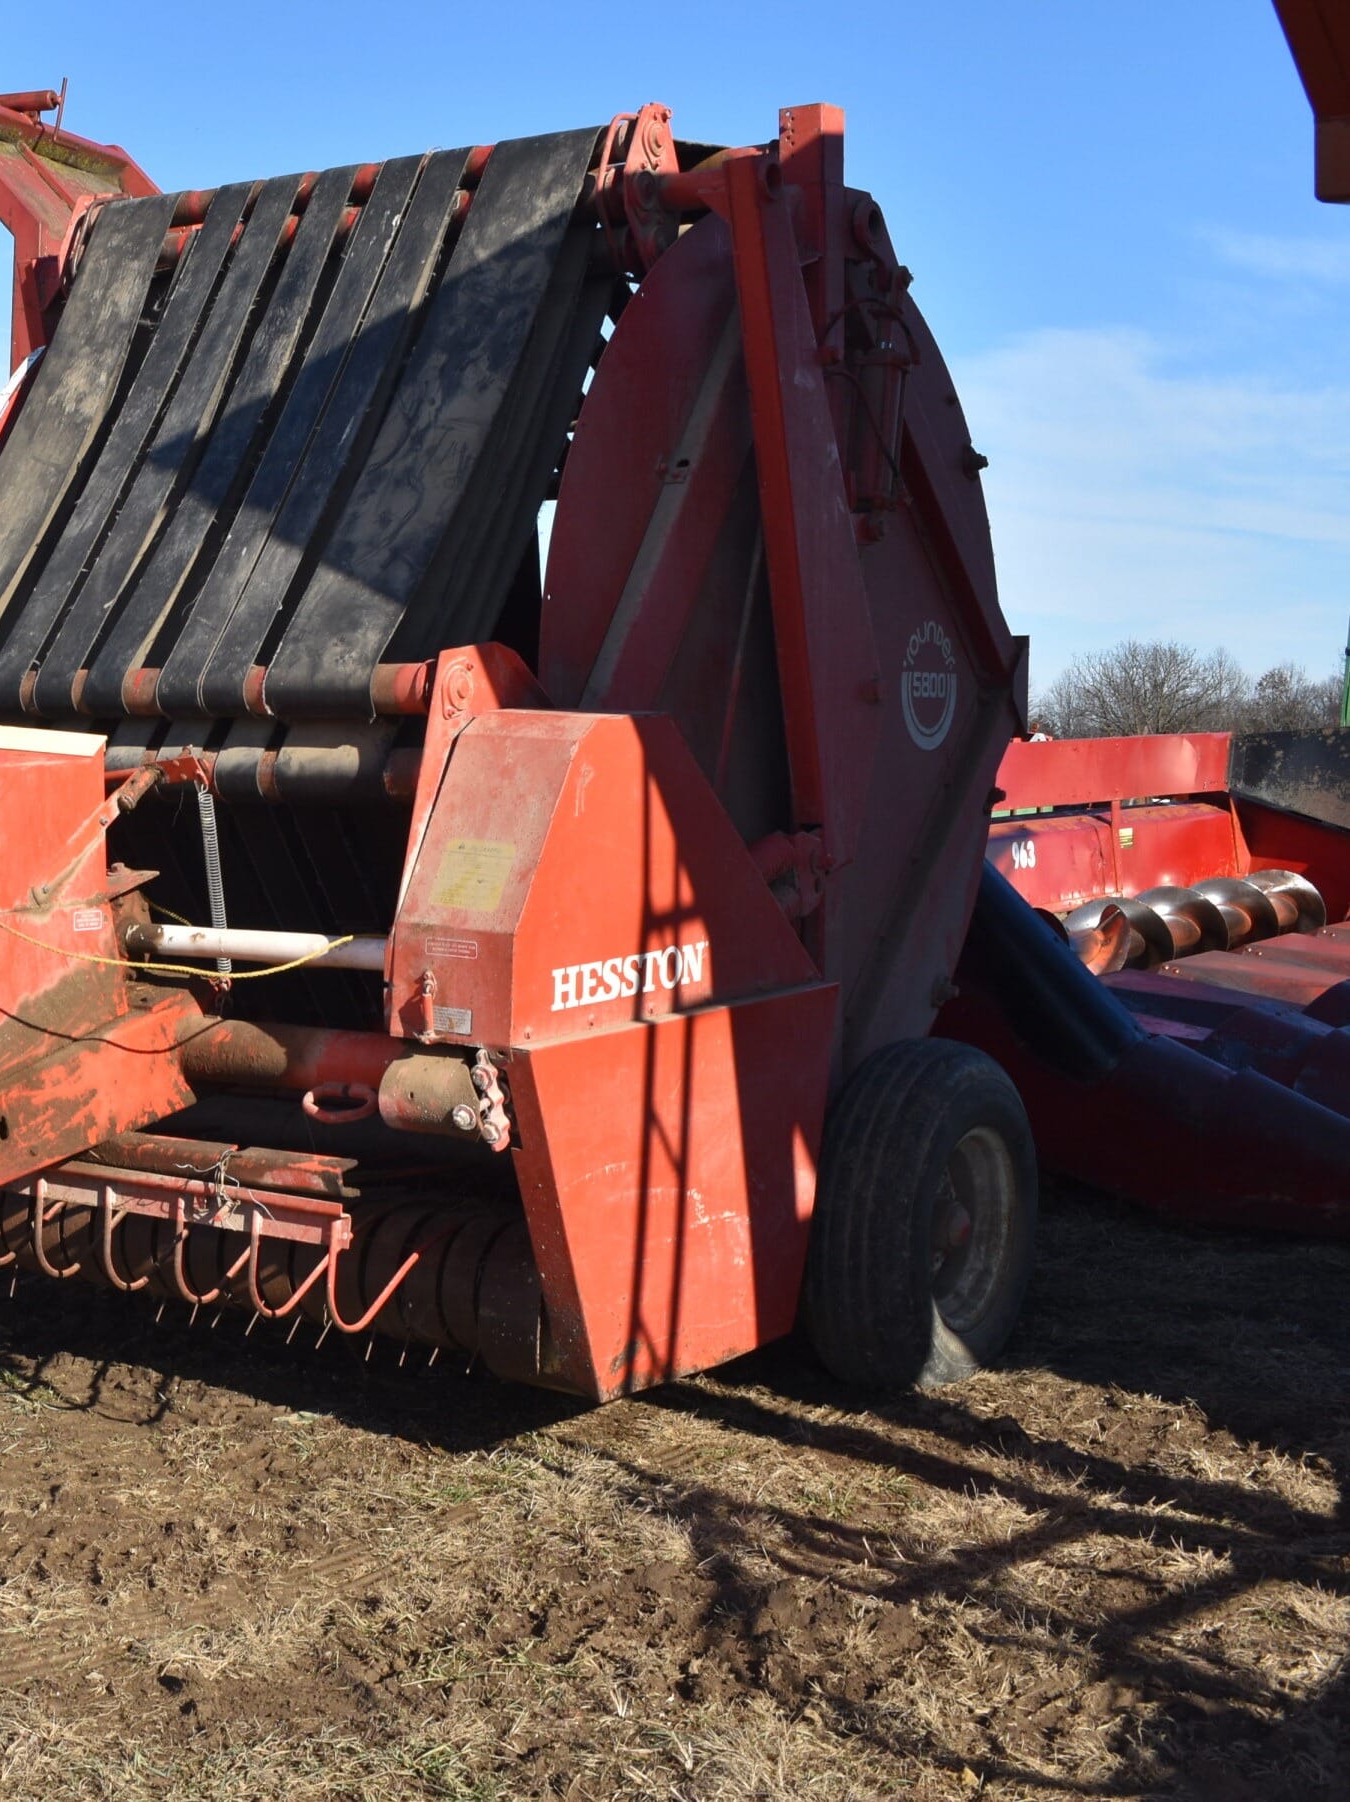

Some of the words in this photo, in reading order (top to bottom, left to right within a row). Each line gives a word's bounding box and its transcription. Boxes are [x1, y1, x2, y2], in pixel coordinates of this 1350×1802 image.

[912, 672, 946, 698] 5800
[1012, 840, 1036, 869] 963
[551, 940, 707, 1012] HESSTON
